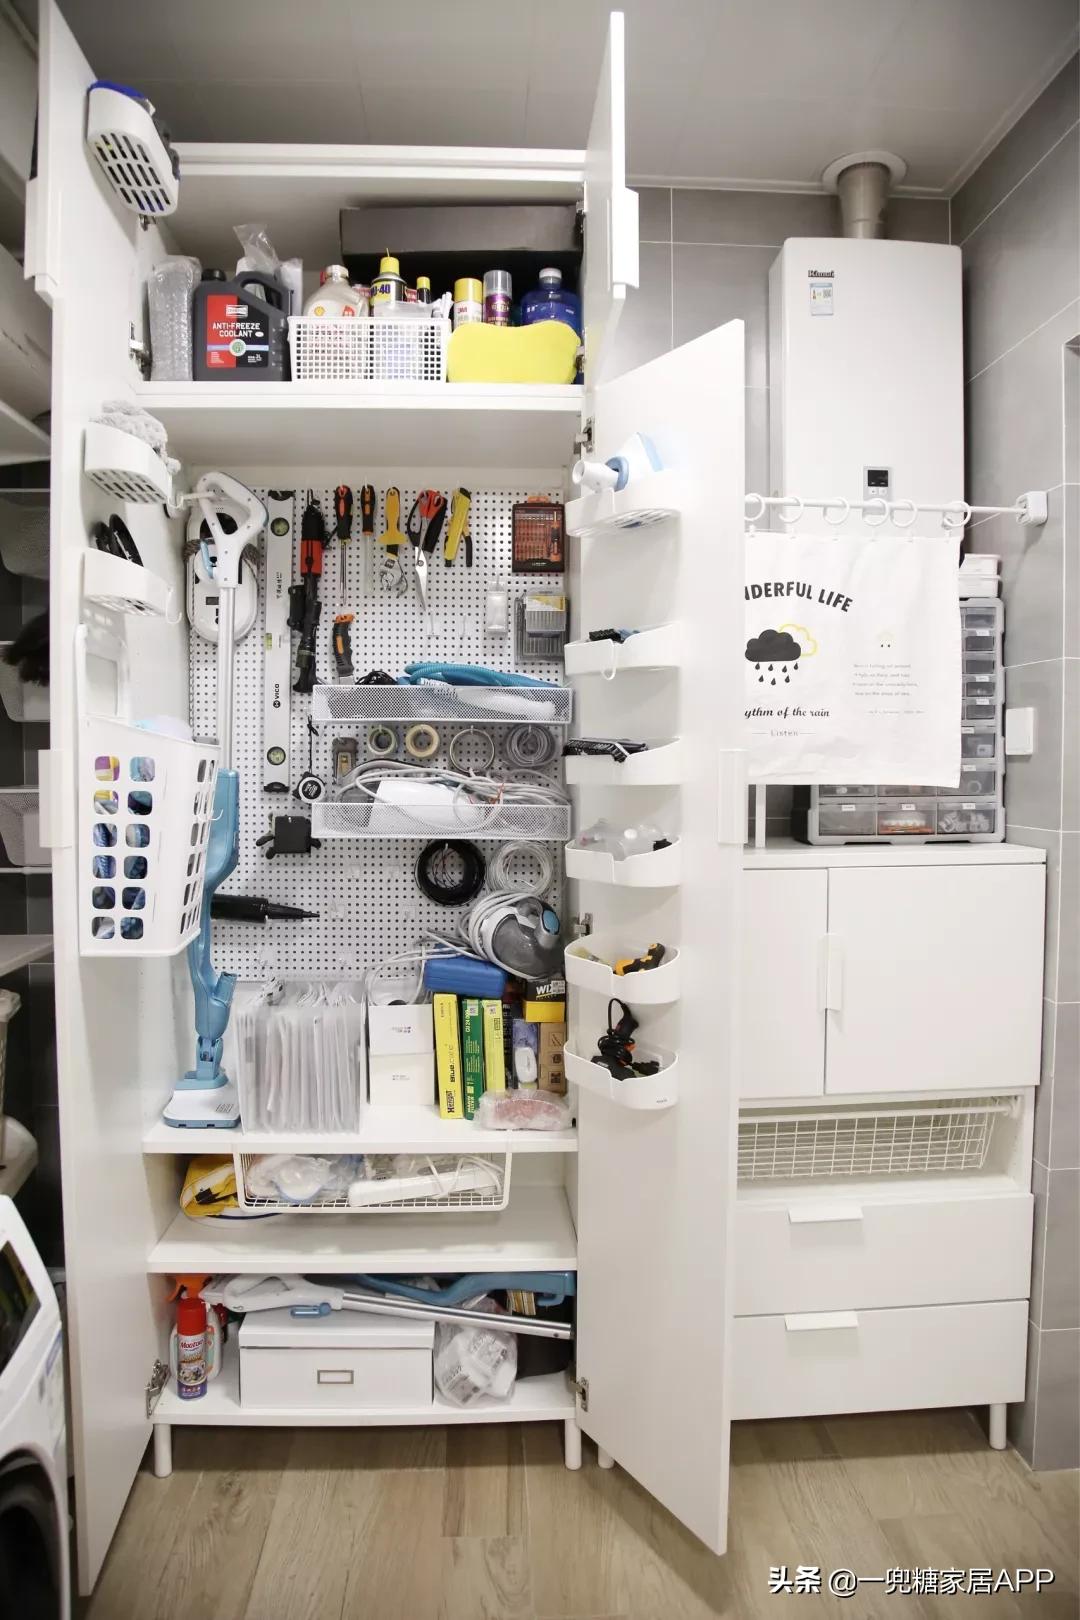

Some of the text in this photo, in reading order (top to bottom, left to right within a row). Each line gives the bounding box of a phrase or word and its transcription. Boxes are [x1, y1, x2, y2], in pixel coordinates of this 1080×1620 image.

[212, 322, 261, 331] ANTI-FREEZE
[219, 330, 253, 338] COOLANT
[818, 589, 853, 612] LIFE
[777, 706, 789, 719] of
[792, 706, 807, 717] the
[810, 708, 830, 717] rain
[770, 729, 799, 737] Listen
